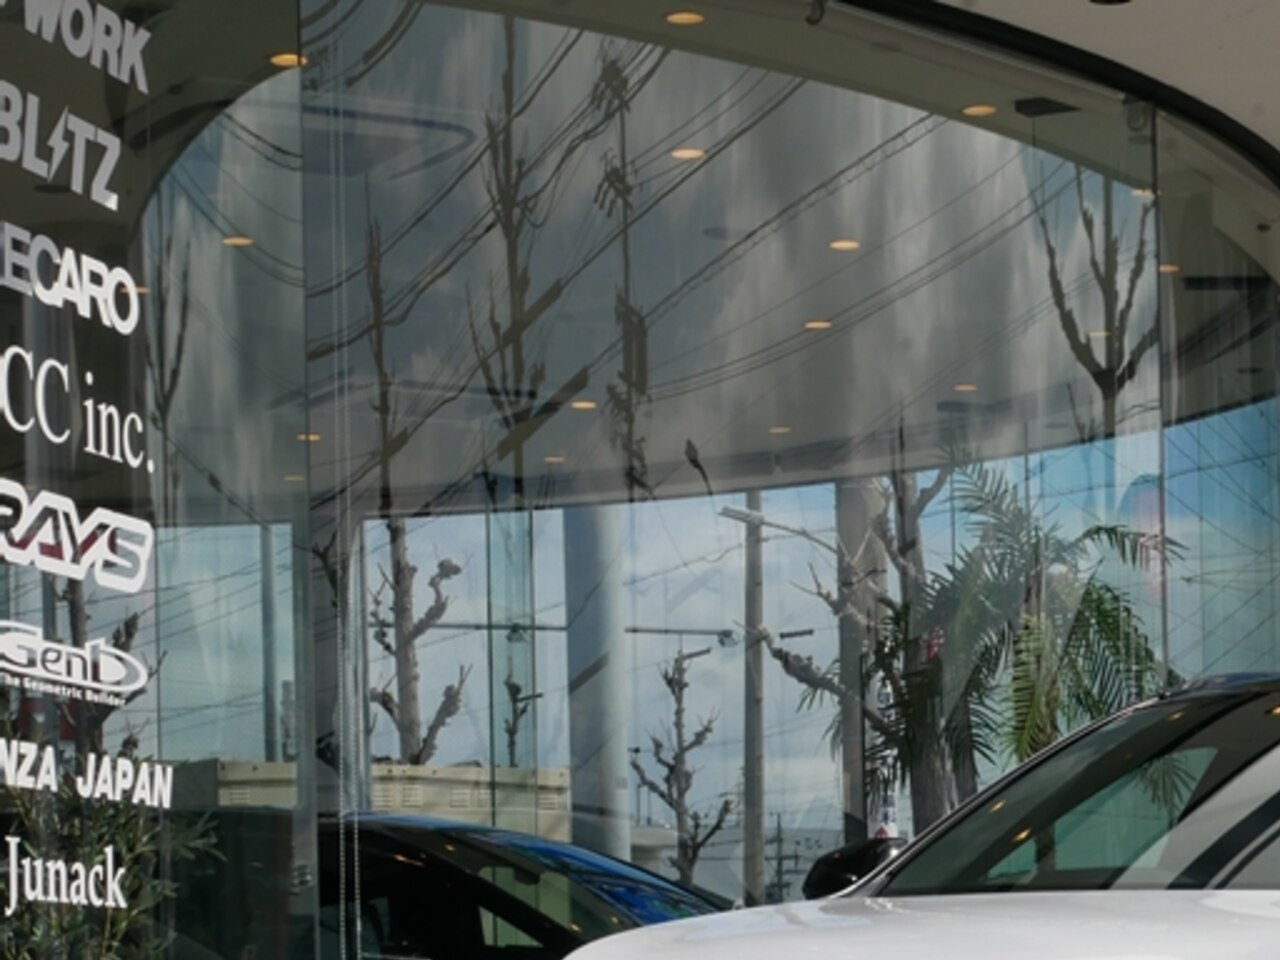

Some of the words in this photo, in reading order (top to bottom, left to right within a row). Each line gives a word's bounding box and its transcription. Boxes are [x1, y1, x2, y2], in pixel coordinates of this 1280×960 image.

[0, 222, 139, 335] ECARO
[0, 345, 71, 444] CC
[84, 372, 155, 473] inc.
[76, 753, 173, 808] JAPAN
[5, 836, 127, 916] Junack
